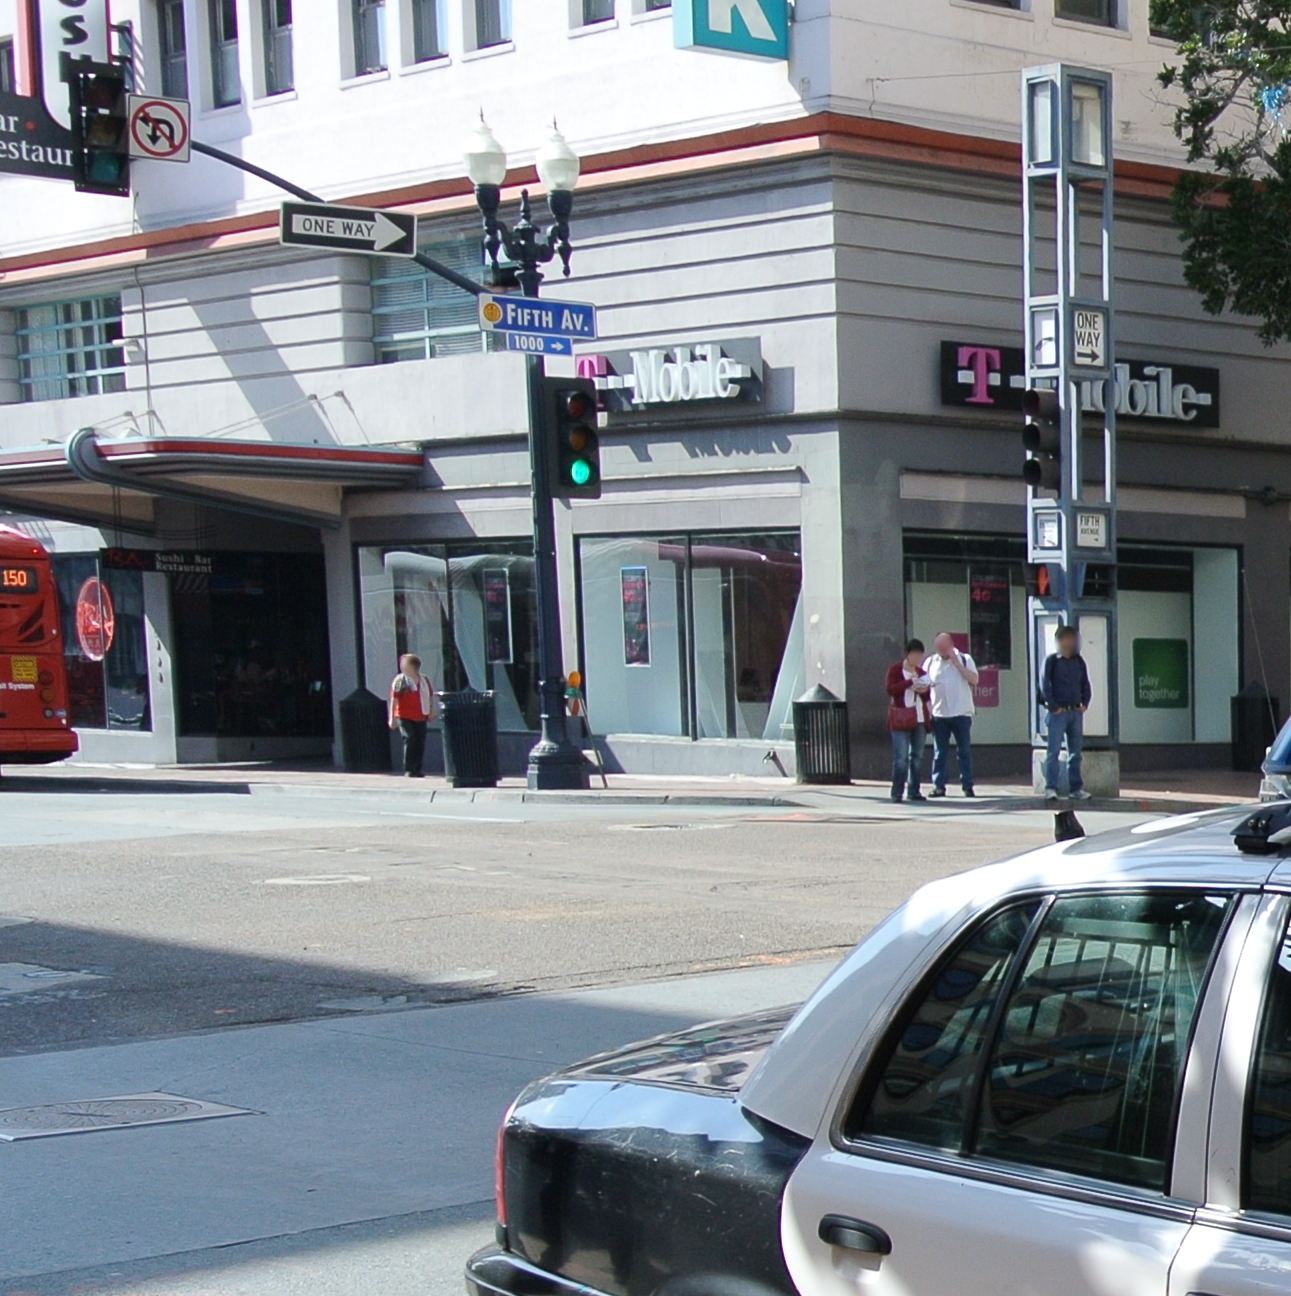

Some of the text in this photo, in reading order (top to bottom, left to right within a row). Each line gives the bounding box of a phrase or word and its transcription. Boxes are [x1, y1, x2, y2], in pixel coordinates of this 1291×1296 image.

[0, 140, 74, 166] estaur
[302, 217, 375, 238] ONE WAY
[506, 306, 589, 332] FIFTH AV.
[1076, 312, 1099, 330] ONE
[514, 335, 544, 351] 1000
[1075, 331, 1101, 348] WAY
[957, 346, 1212, 421] T-obile
[1080, 515, 1100, 527] FIFTH
[155, 552, 212, 565] Sushi Bar
[155, 562, 213, 574] Restaurant
[3, 569, 28, 587] 150
[1138, 675, 1159, 690] play
[1138, 687, 1180, 703] together
